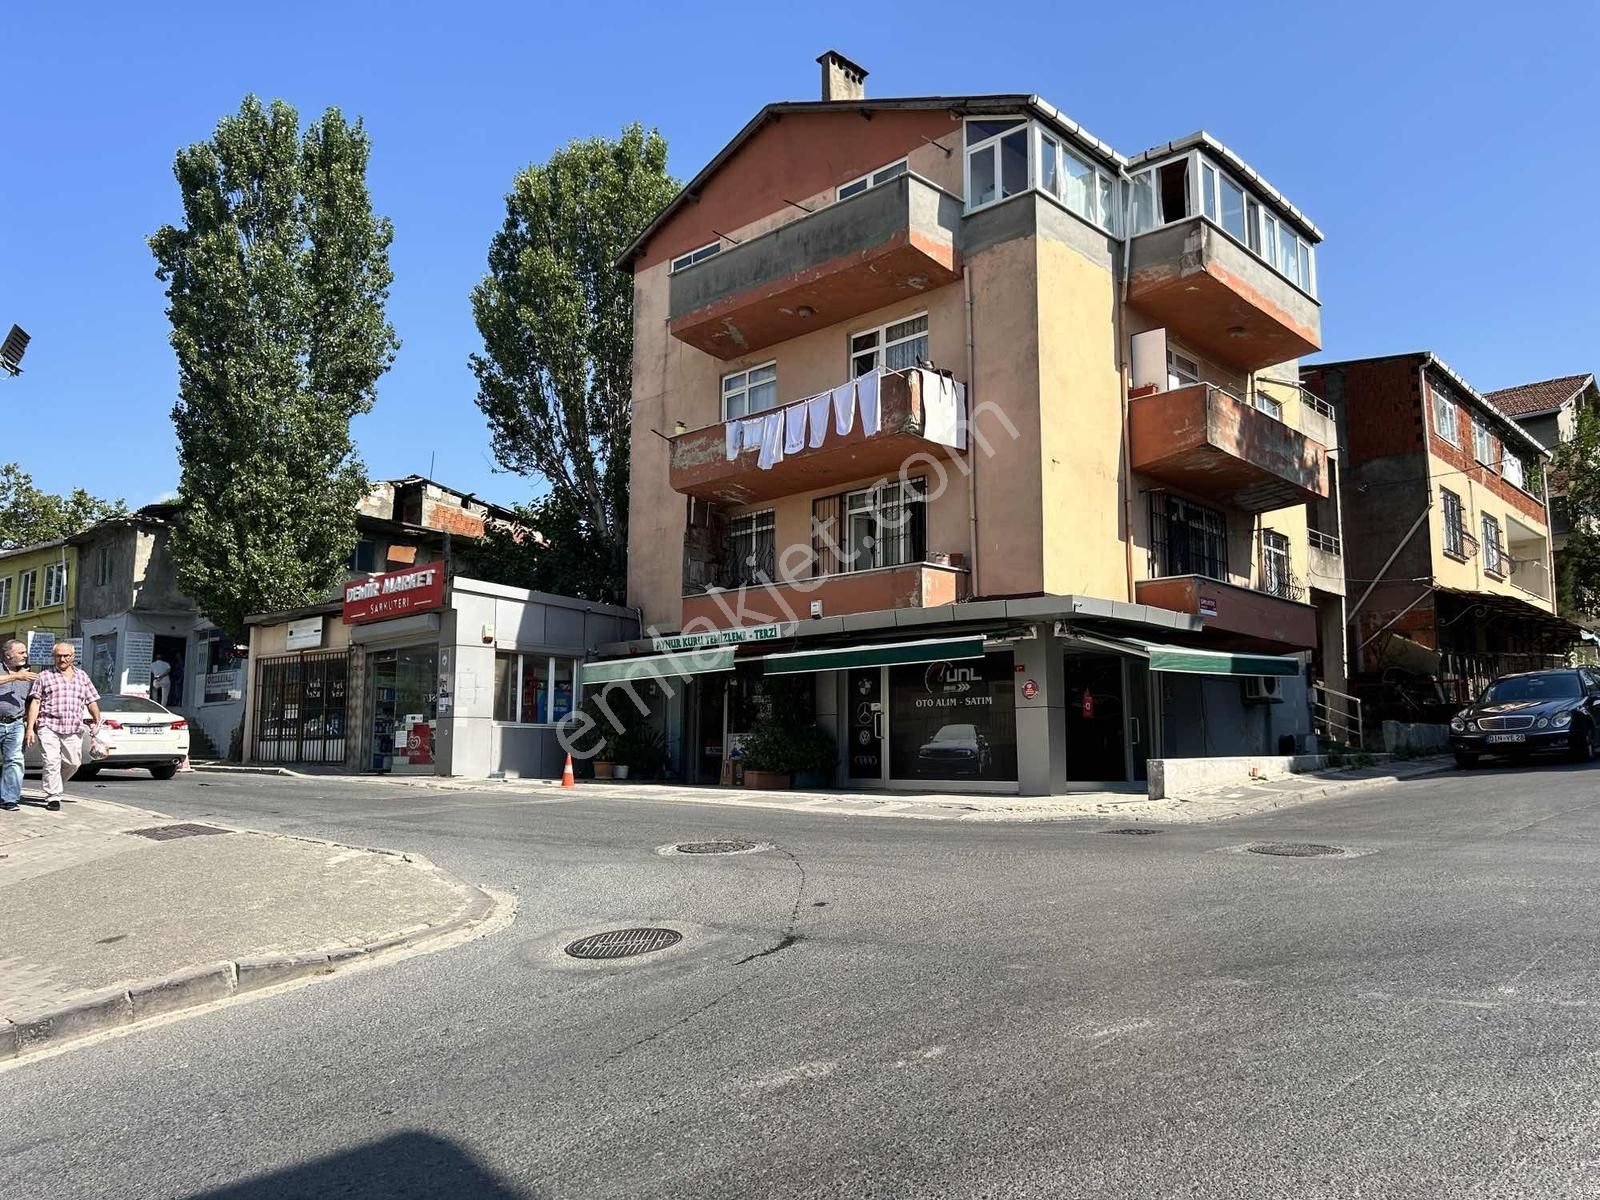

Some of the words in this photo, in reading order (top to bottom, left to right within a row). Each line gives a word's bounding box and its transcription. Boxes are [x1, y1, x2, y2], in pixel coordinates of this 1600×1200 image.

[382, 569, 435, 594] MARKET
[656, 639, 681, 650] AYNUR
[753, 625, 777, 640] TERZİ
[915, 699, 934, 707] OTO
[935, 698, 957, 706] ALIM
[965, 696, 993, 705] SATIM
